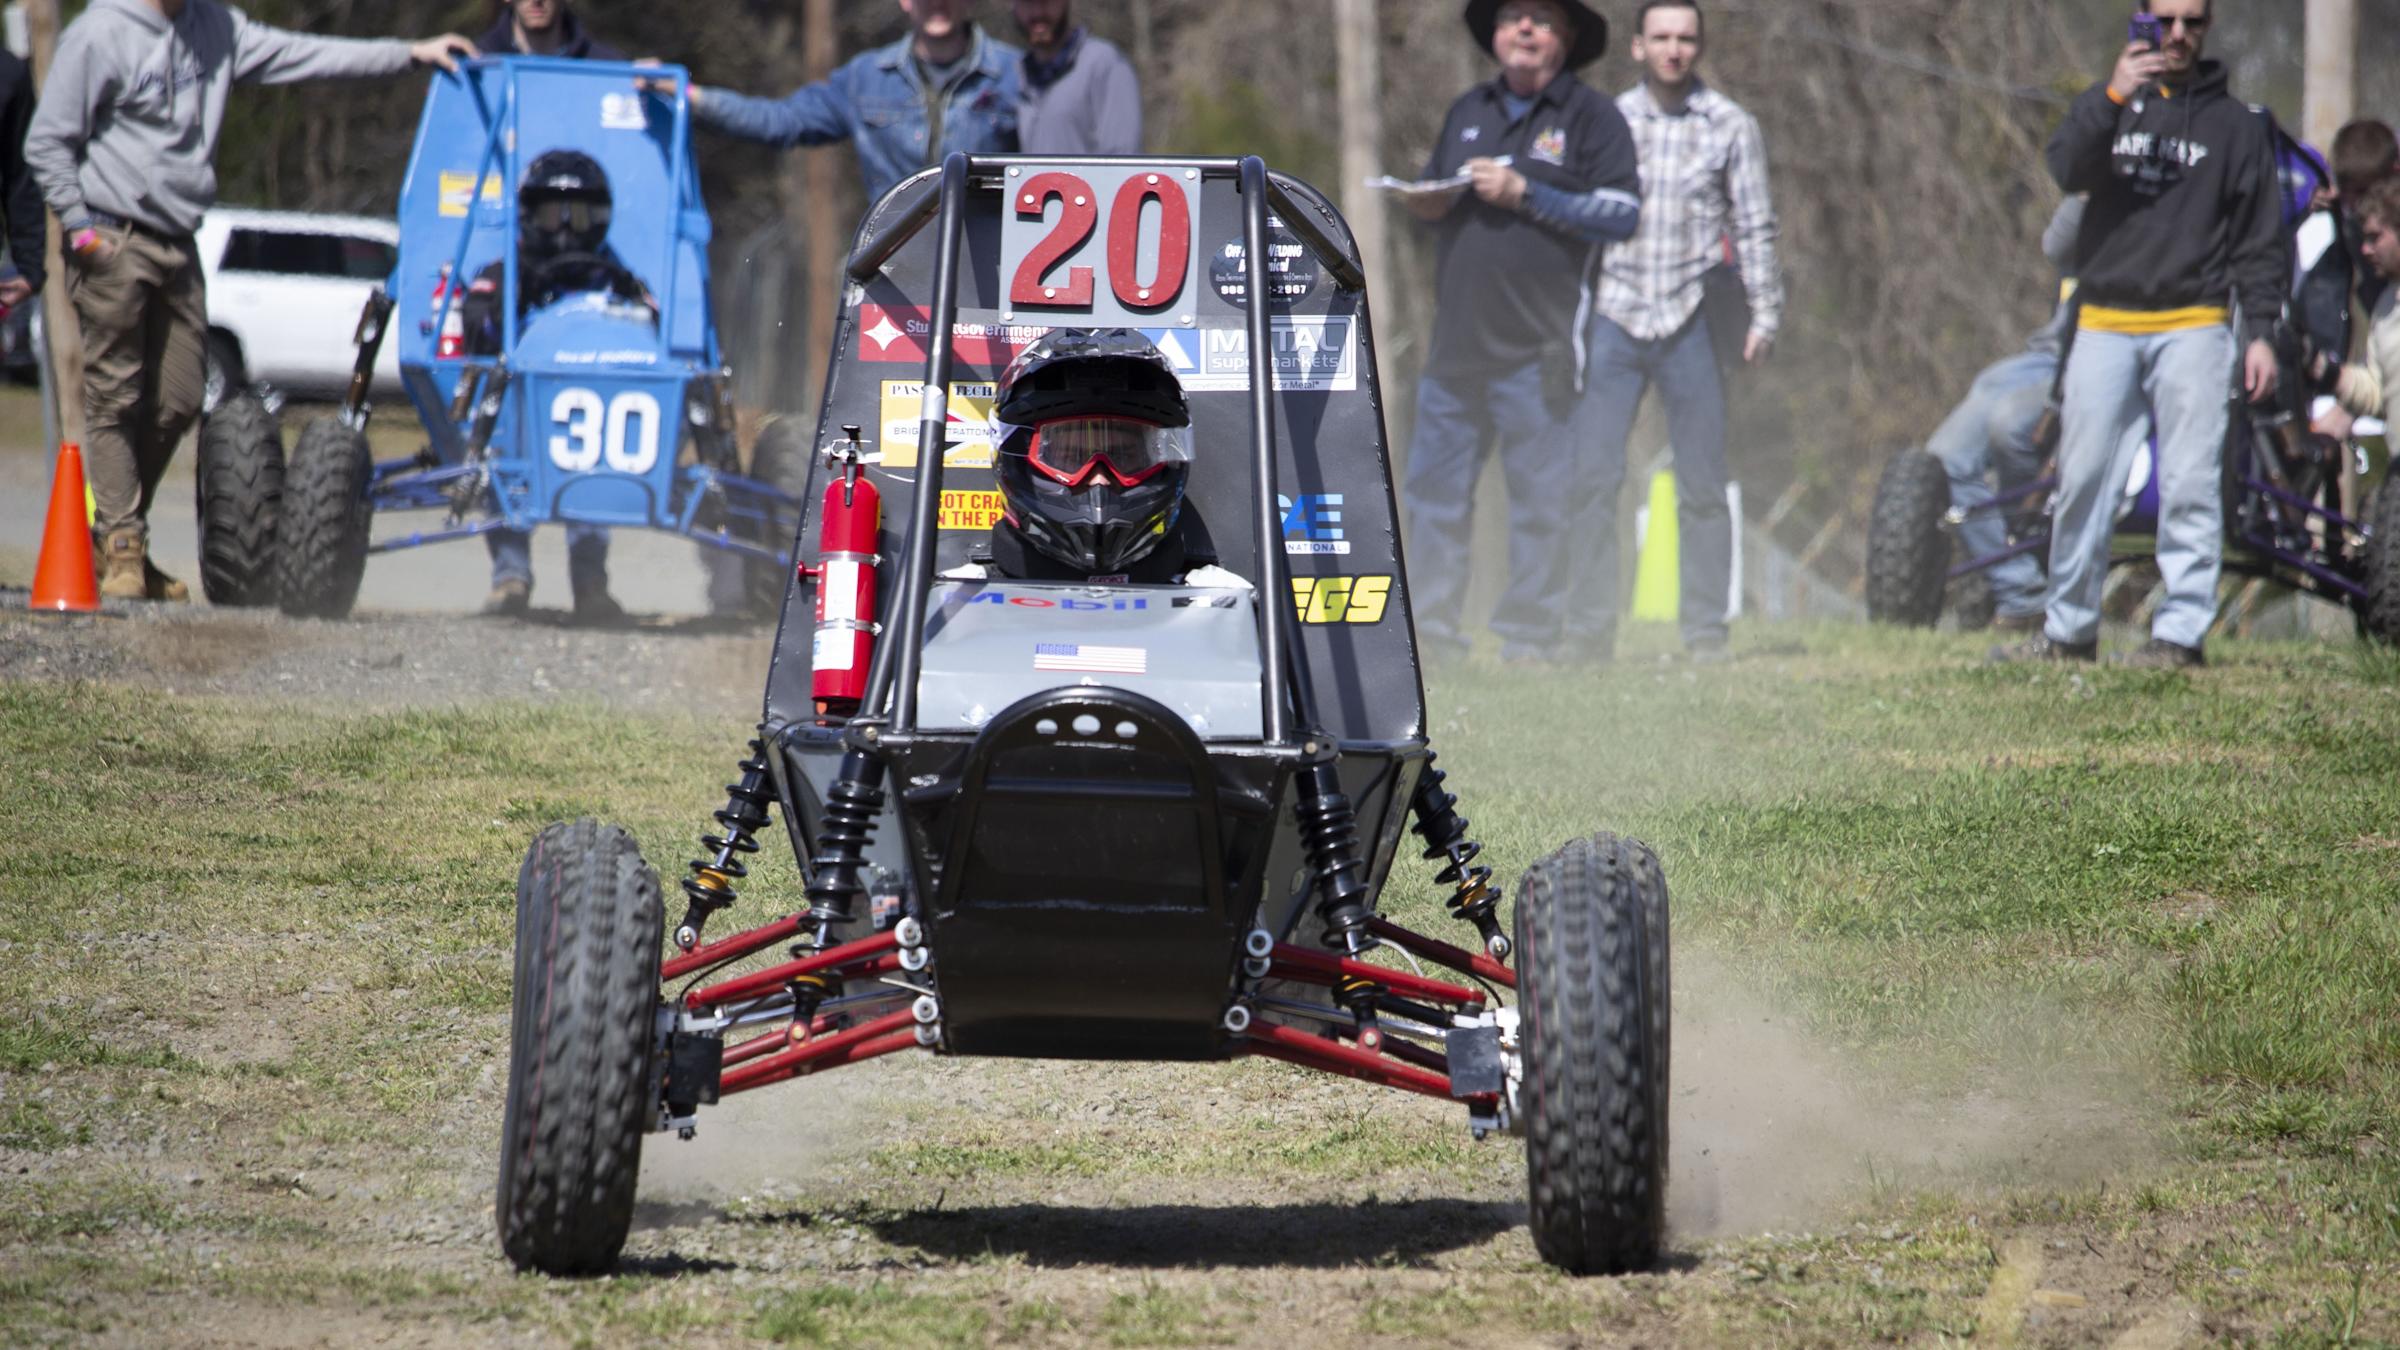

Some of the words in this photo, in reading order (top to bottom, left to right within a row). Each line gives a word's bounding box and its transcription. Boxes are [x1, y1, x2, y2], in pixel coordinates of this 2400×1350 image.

[1010, 172, 1191, 307] 20
[1211, 326, 1340, 353] MTAL
[1212, 354, 1340, 371] supmarkets
[955, 385, 993, 396] TECH
[549, 387, 661, 475] 30
[894, 427, 919, 436] BRIG
[945, 428, 991, 437] TRATTON
[940, 494, 965, 509] OT
[971, 494, 1004, 510] CRA
[952, 511, 982, 527] THE
[945, 592, 1147, 610] Mobil
